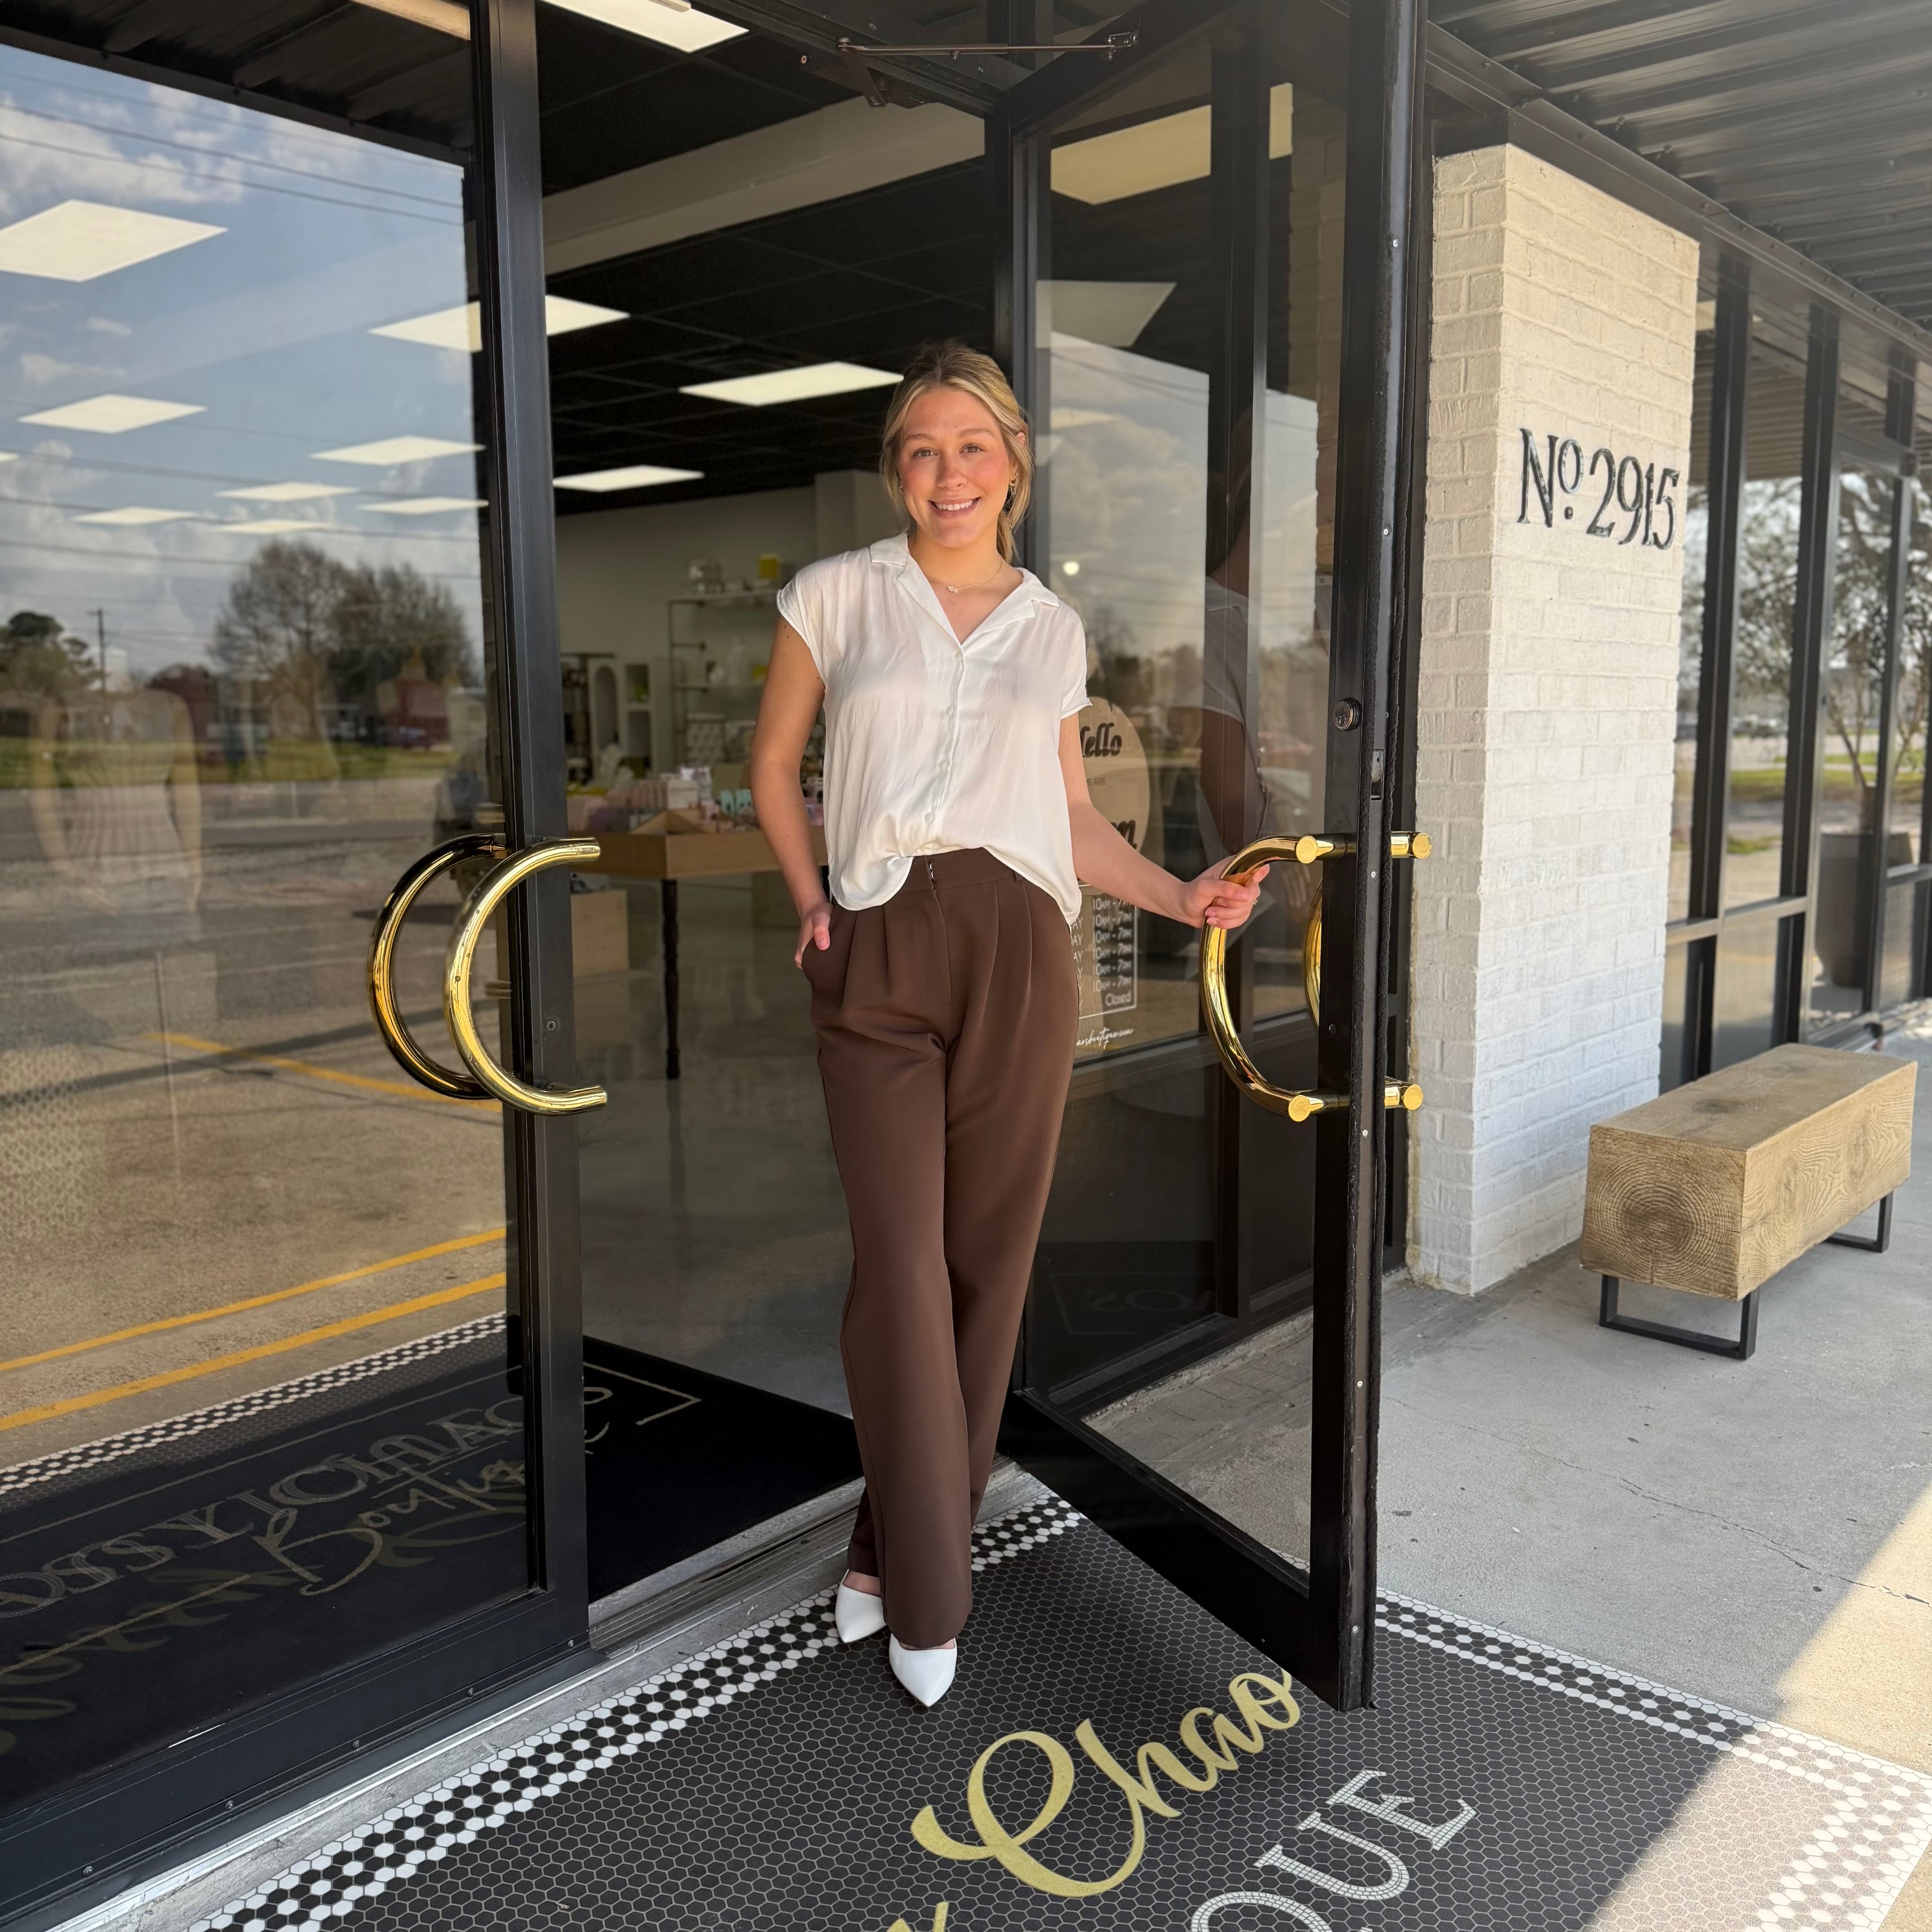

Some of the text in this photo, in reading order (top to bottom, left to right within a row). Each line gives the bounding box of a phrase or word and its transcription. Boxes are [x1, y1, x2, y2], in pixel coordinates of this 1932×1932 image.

[1586, 448, 1680, 550] 2915
[1086, 777, 1106, 786] E ARE
[1118, 911, 1131, 924] 7PM
[1118, 927, 1131, 940] 7PM
[1118, 943, 1131, 956] 7PM
[1118, 959, 1131, 972] 7PM
[1118, 975, 1131, 988] 7PM
[1105, 990, 1131, 1006] Closed
